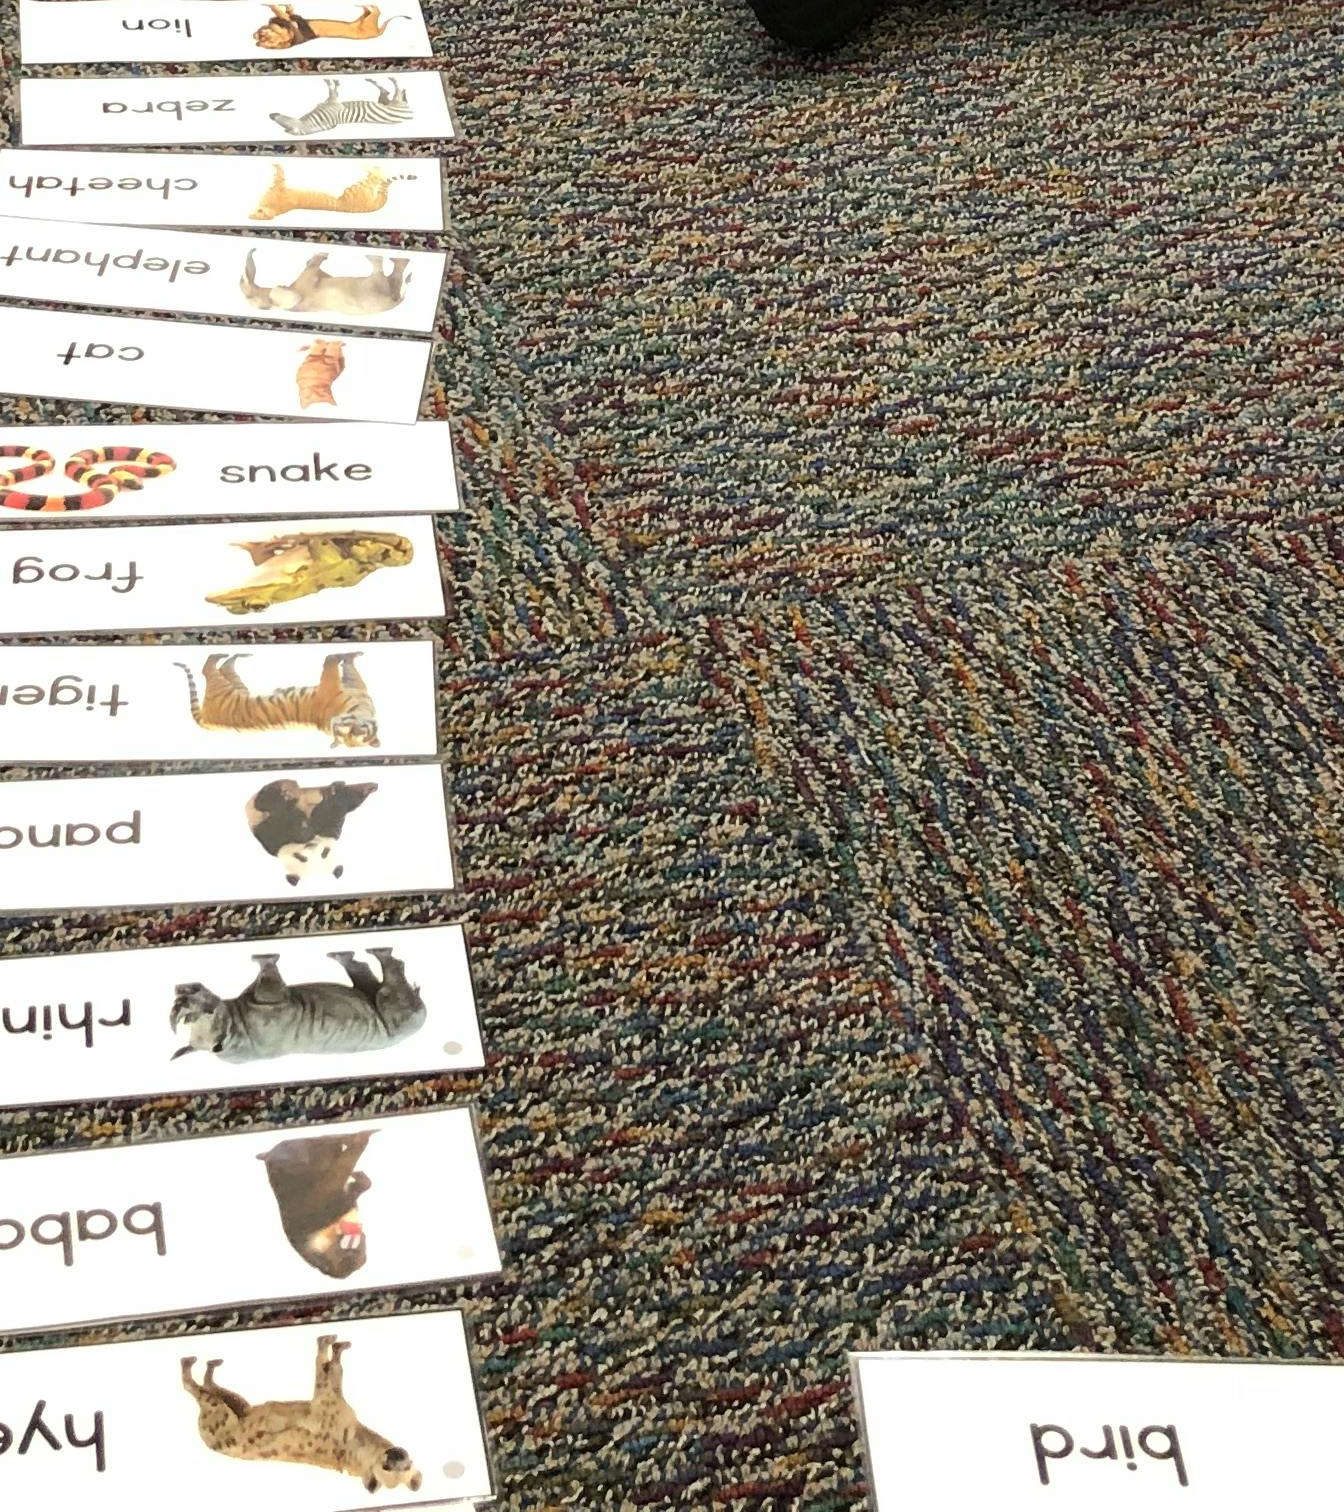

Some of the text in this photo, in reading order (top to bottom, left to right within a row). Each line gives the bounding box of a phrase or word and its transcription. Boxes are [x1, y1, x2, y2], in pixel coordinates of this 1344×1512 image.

[122, 19, 192, 38] lion
[103, 100, 235, 120] zebra
[9, 176, 197, 199] cheetah
[0, 246, 210, 282] elephant
[57, 342, 144, 365] cat
[220, 452, 372, 483] snake
[13, 557, 144, 593] frog
[1030, 1423, 1189, 1487] bird
